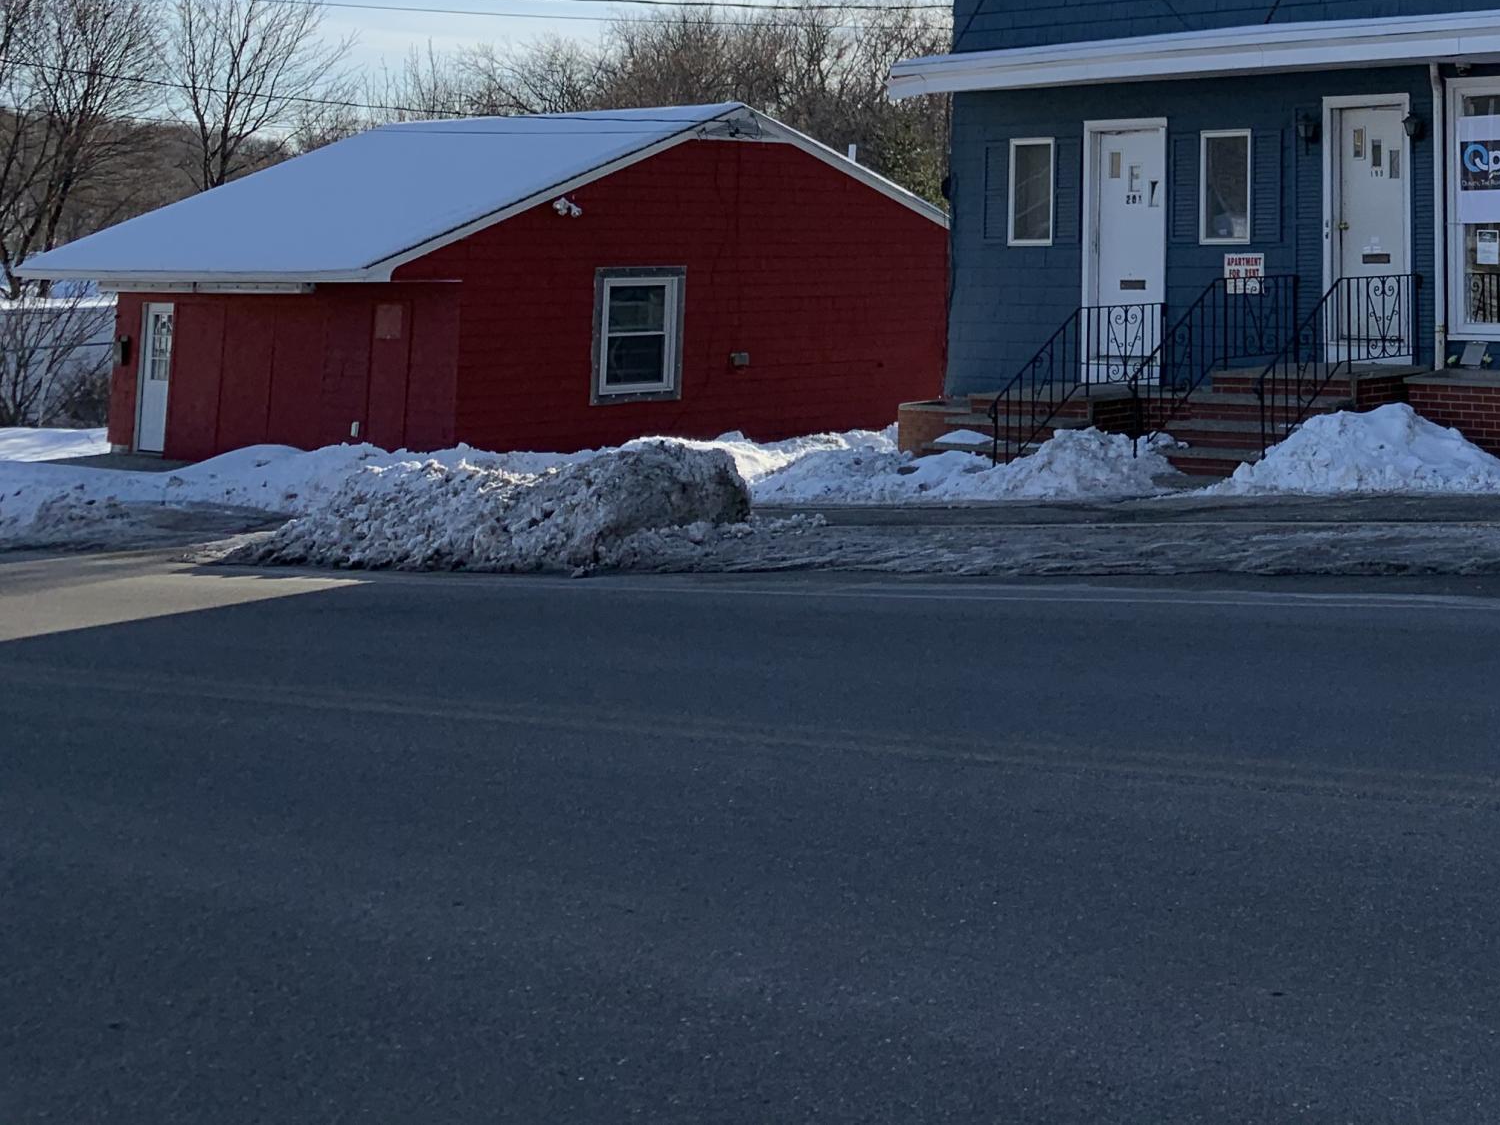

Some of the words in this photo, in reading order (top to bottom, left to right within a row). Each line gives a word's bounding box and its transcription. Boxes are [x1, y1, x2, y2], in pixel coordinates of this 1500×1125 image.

[1226, 257, 1262, 266] APARTMENT
[1229, 269, 1240, 278] FOR
[1244, 268, 1260, 277] RENT
